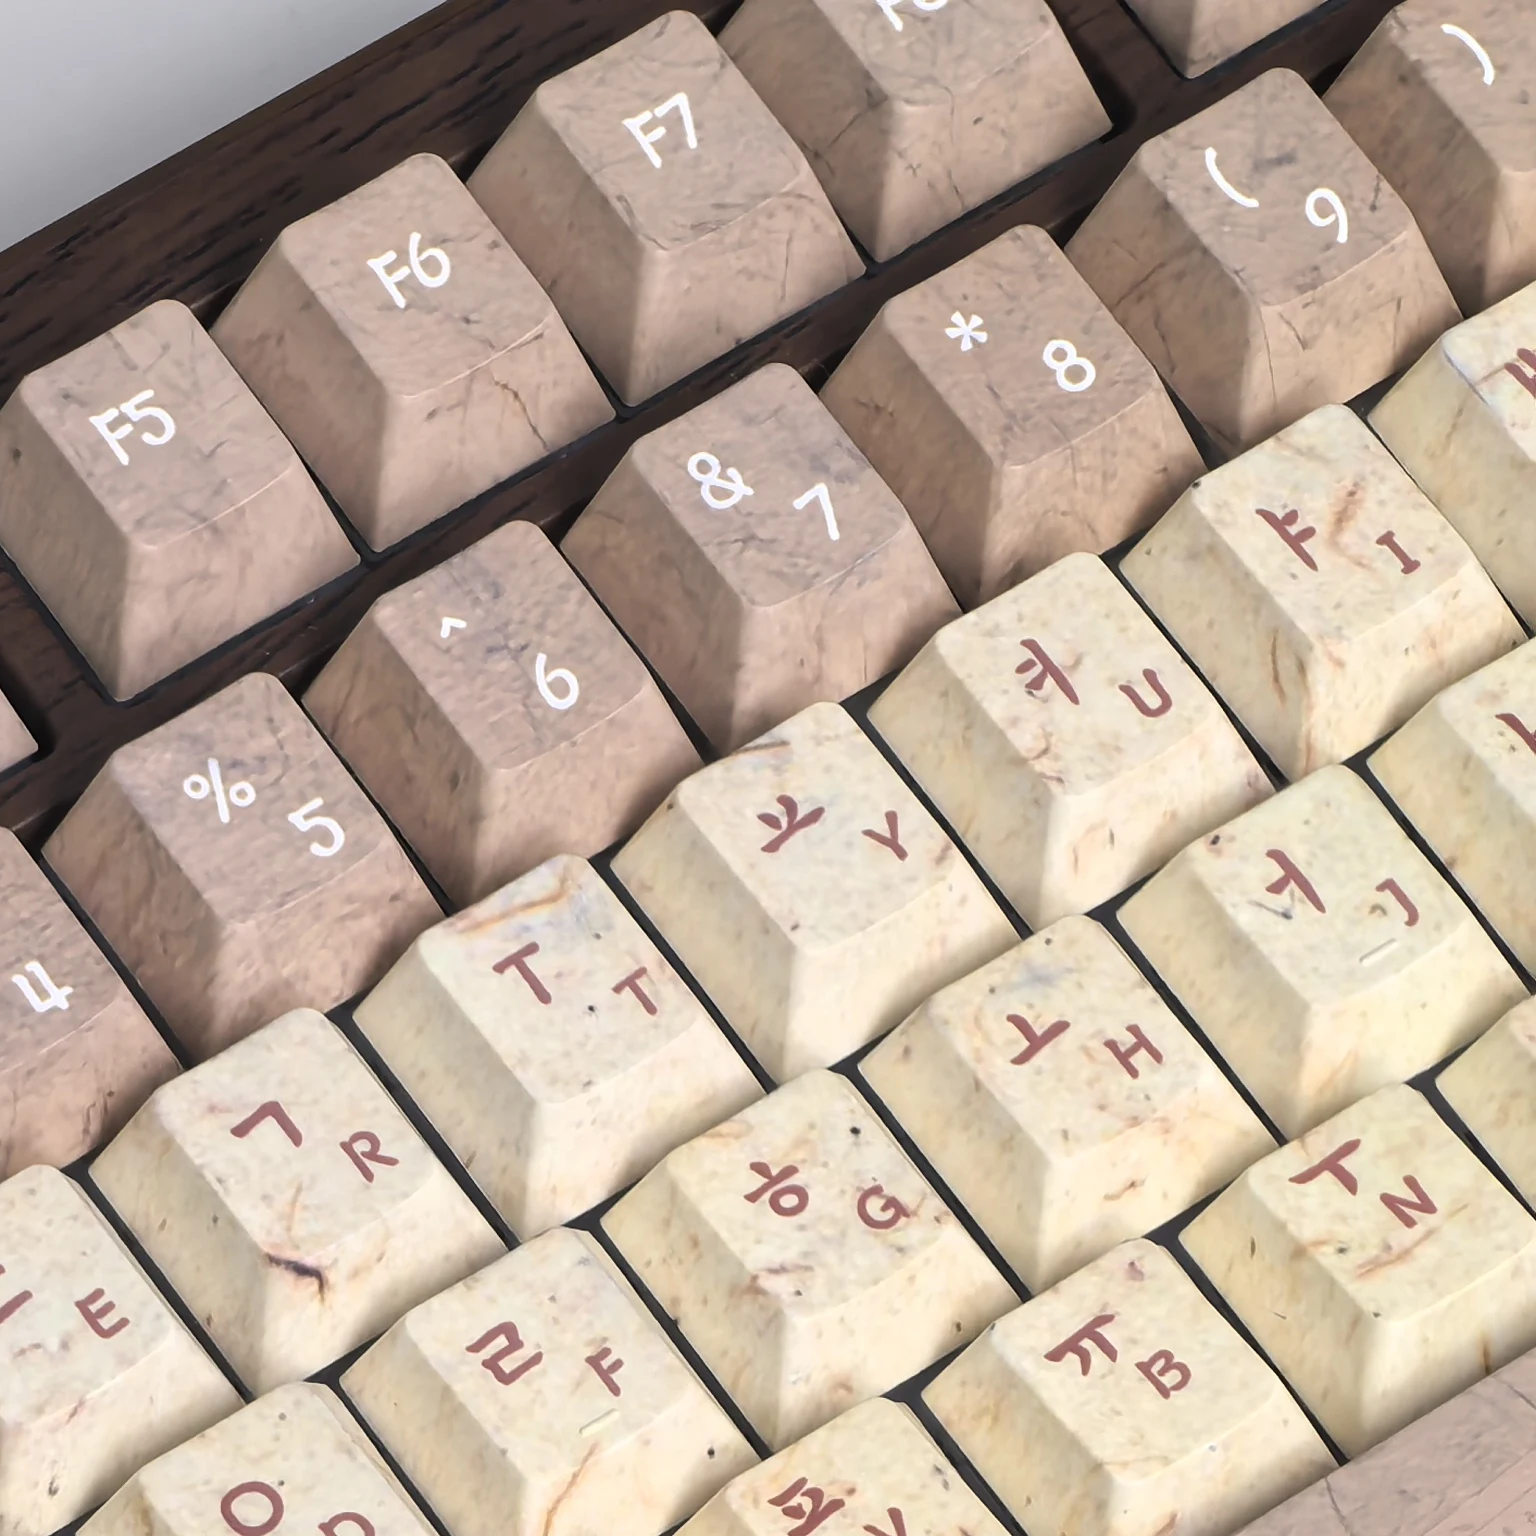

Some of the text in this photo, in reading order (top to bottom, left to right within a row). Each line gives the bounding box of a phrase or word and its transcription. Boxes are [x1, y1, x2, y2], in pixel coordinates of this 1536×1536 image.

[623, 94, 698, 169] F7
[1304, 189, 1348, 244] 9
[367, 232, 451, 309] F6
[1042, 340, 1096, 393] 8
[88, 390, 176, 466] F5
[792, 484, 840, 542] 7
[1375, 532, 1421, 575] I
[535, 652, 580, 711] 6
[1118, 669, 1173, 718] U
[182, 758, 257, 824] %
[287, 799, 345, 857] 5
[864, 810, 907, 861] Y
[1374, 878, 1419, 927] J
[11, 962, 74, 1013] 4
[613, 966, 658, 1016] T
[1102, 1024, 1163, 1079] H
[340, 1131, 399, 1183] R
[856, 1184, 911, 1230] G
[1379, 1174, 1438, 1229] N
[75, 1289, 129, 1339] E
[585, 1348, 622, 1397] F
[1134, 1349, 1191, 1400] B
